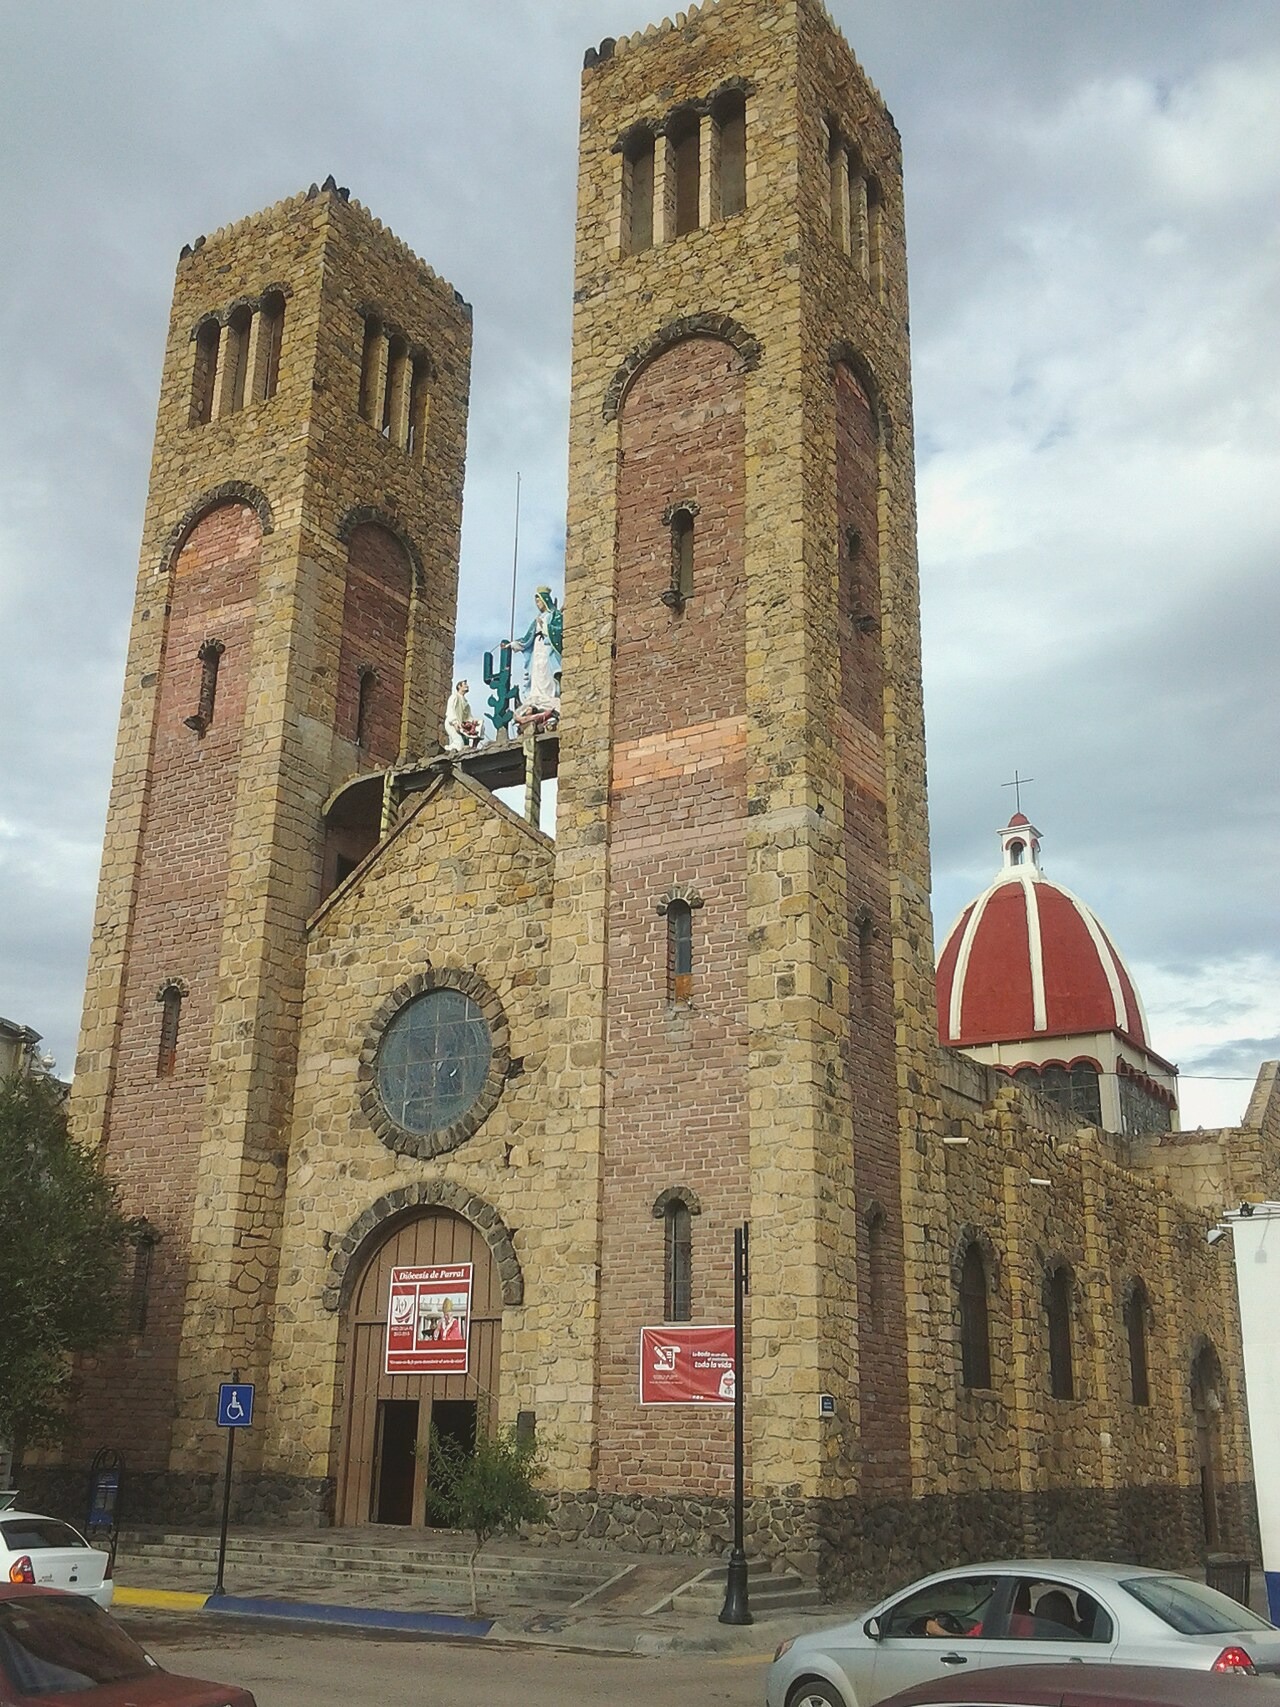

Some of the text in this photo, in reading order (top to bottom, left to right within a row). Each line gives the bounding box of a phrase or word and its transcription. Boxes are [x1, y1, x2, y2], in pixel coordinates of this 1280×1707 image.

[430, 1270, 439, 1279] de
[440, 1268, 465, 1279] Parral
[694, 1360, 732, 1368] toda la vida
